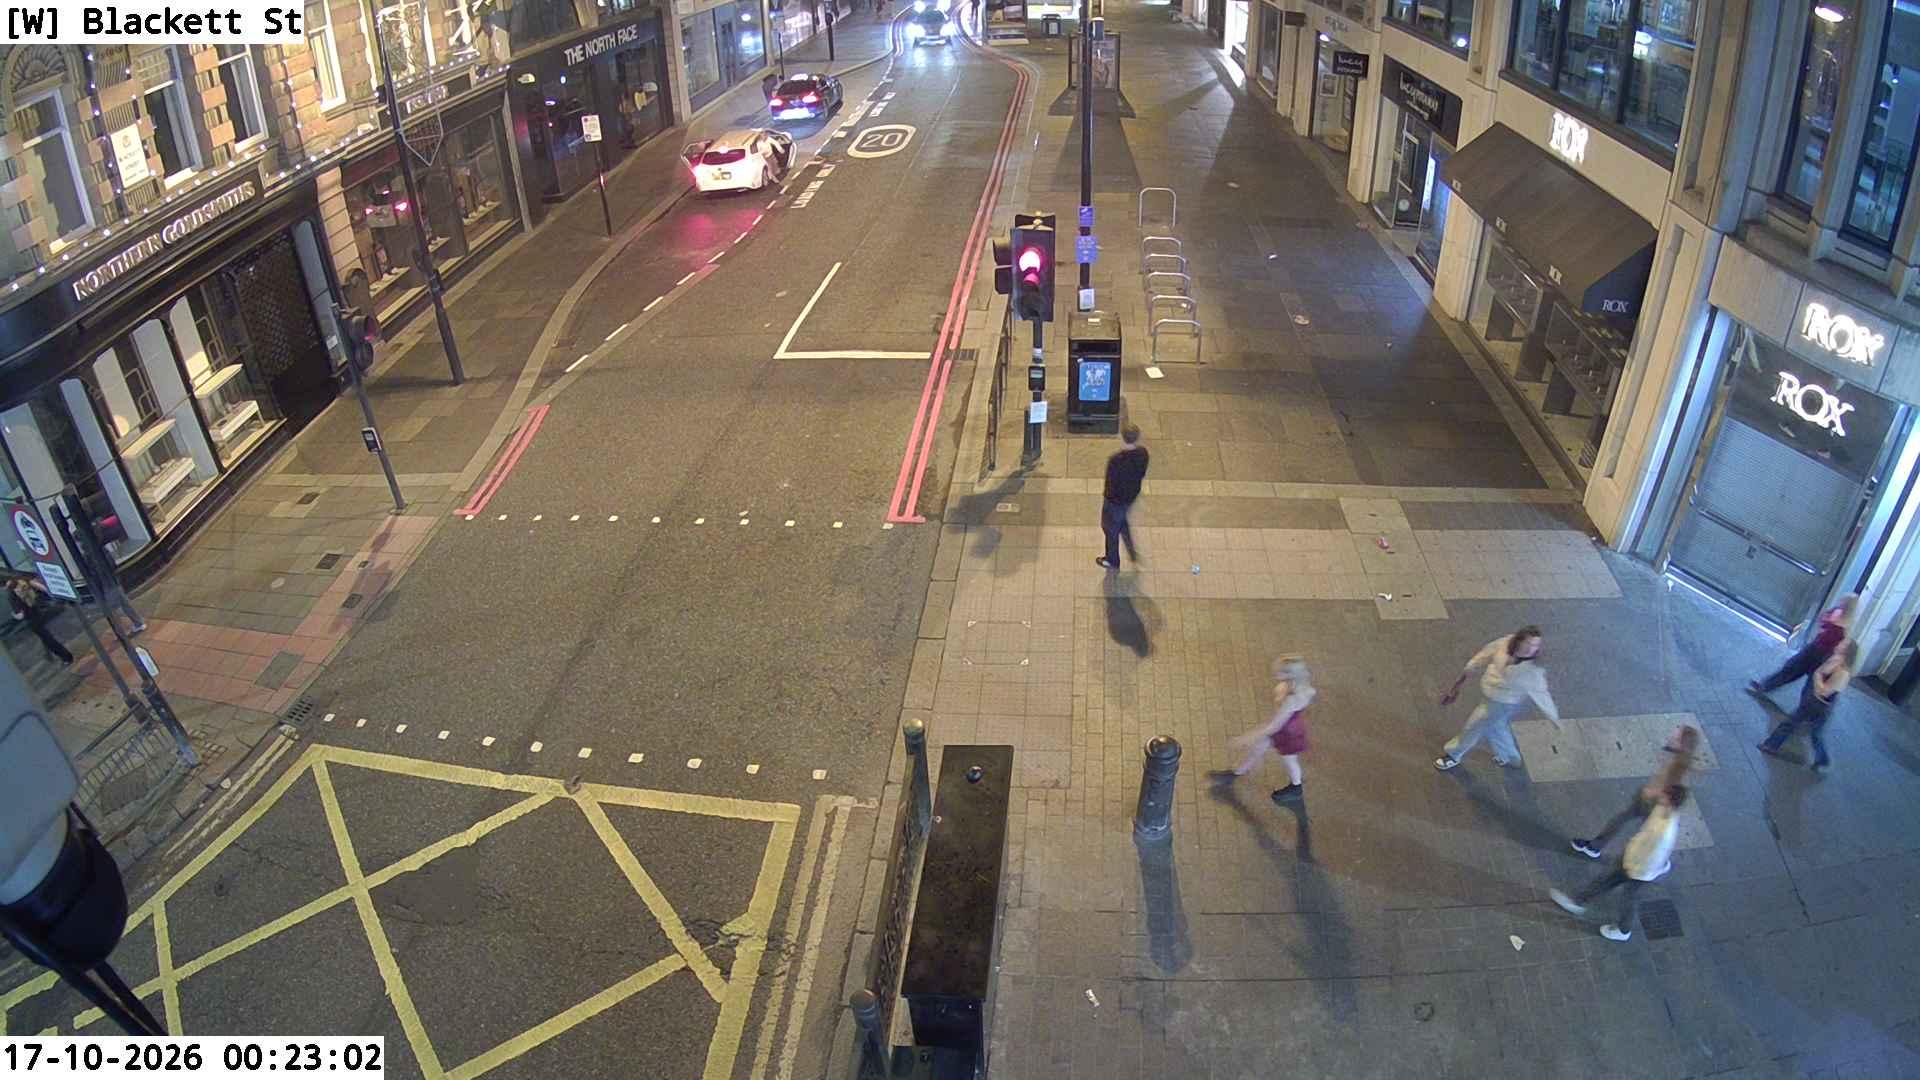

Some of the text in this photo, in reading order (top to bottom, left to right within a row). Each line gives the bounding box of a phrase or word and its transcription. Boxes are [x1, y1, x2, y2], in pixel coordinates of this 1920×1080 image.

[564, 24, 638, 66] THE NORTH FACE
[861, 132, 903, 148] 20
[72, 181, 256, 301] NORTHERN GOLDSMITHS
[1602, 299, 1629, 313] ROX
[1802, 302, 1885, 366] ROX
[1770, 371, 1855, 436] ROX
